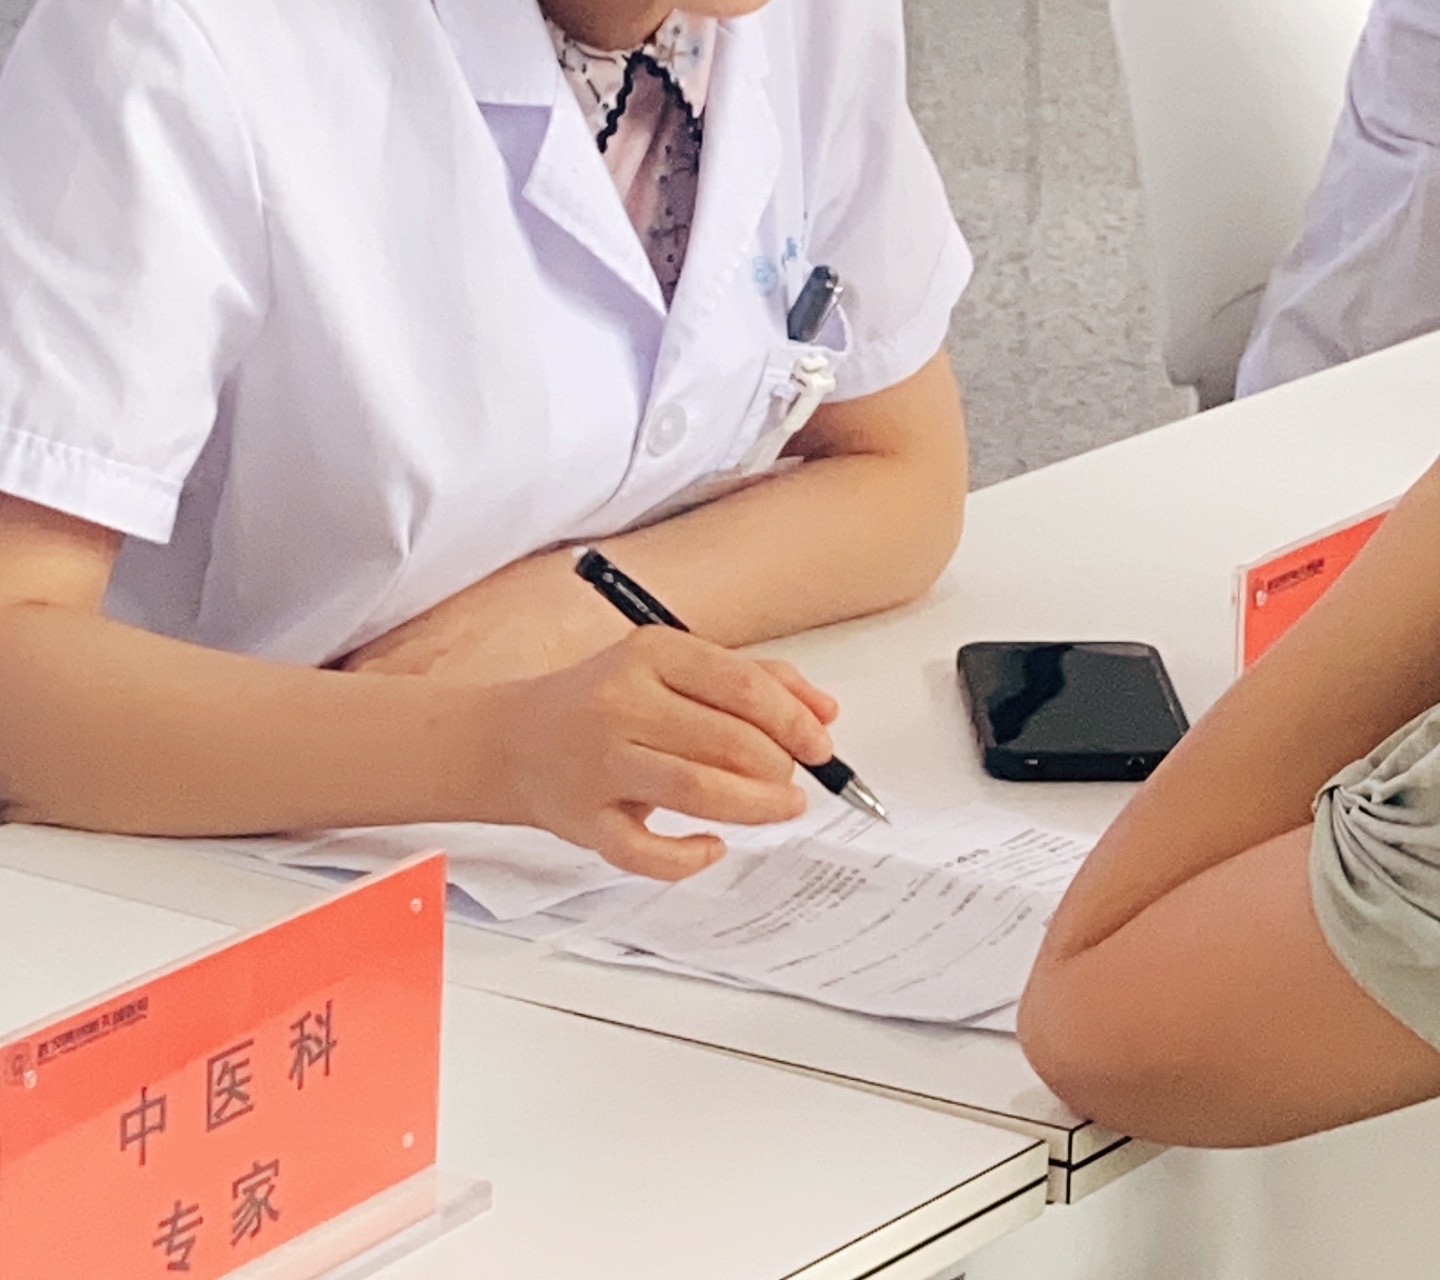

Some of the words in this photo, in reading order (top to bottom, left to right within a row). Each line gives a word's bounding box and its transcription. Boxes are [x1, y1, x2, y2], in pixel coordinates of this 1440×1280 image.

[119, 998, 338, 1166] 中医科
[152, 1158, 280, 1271] 专家
